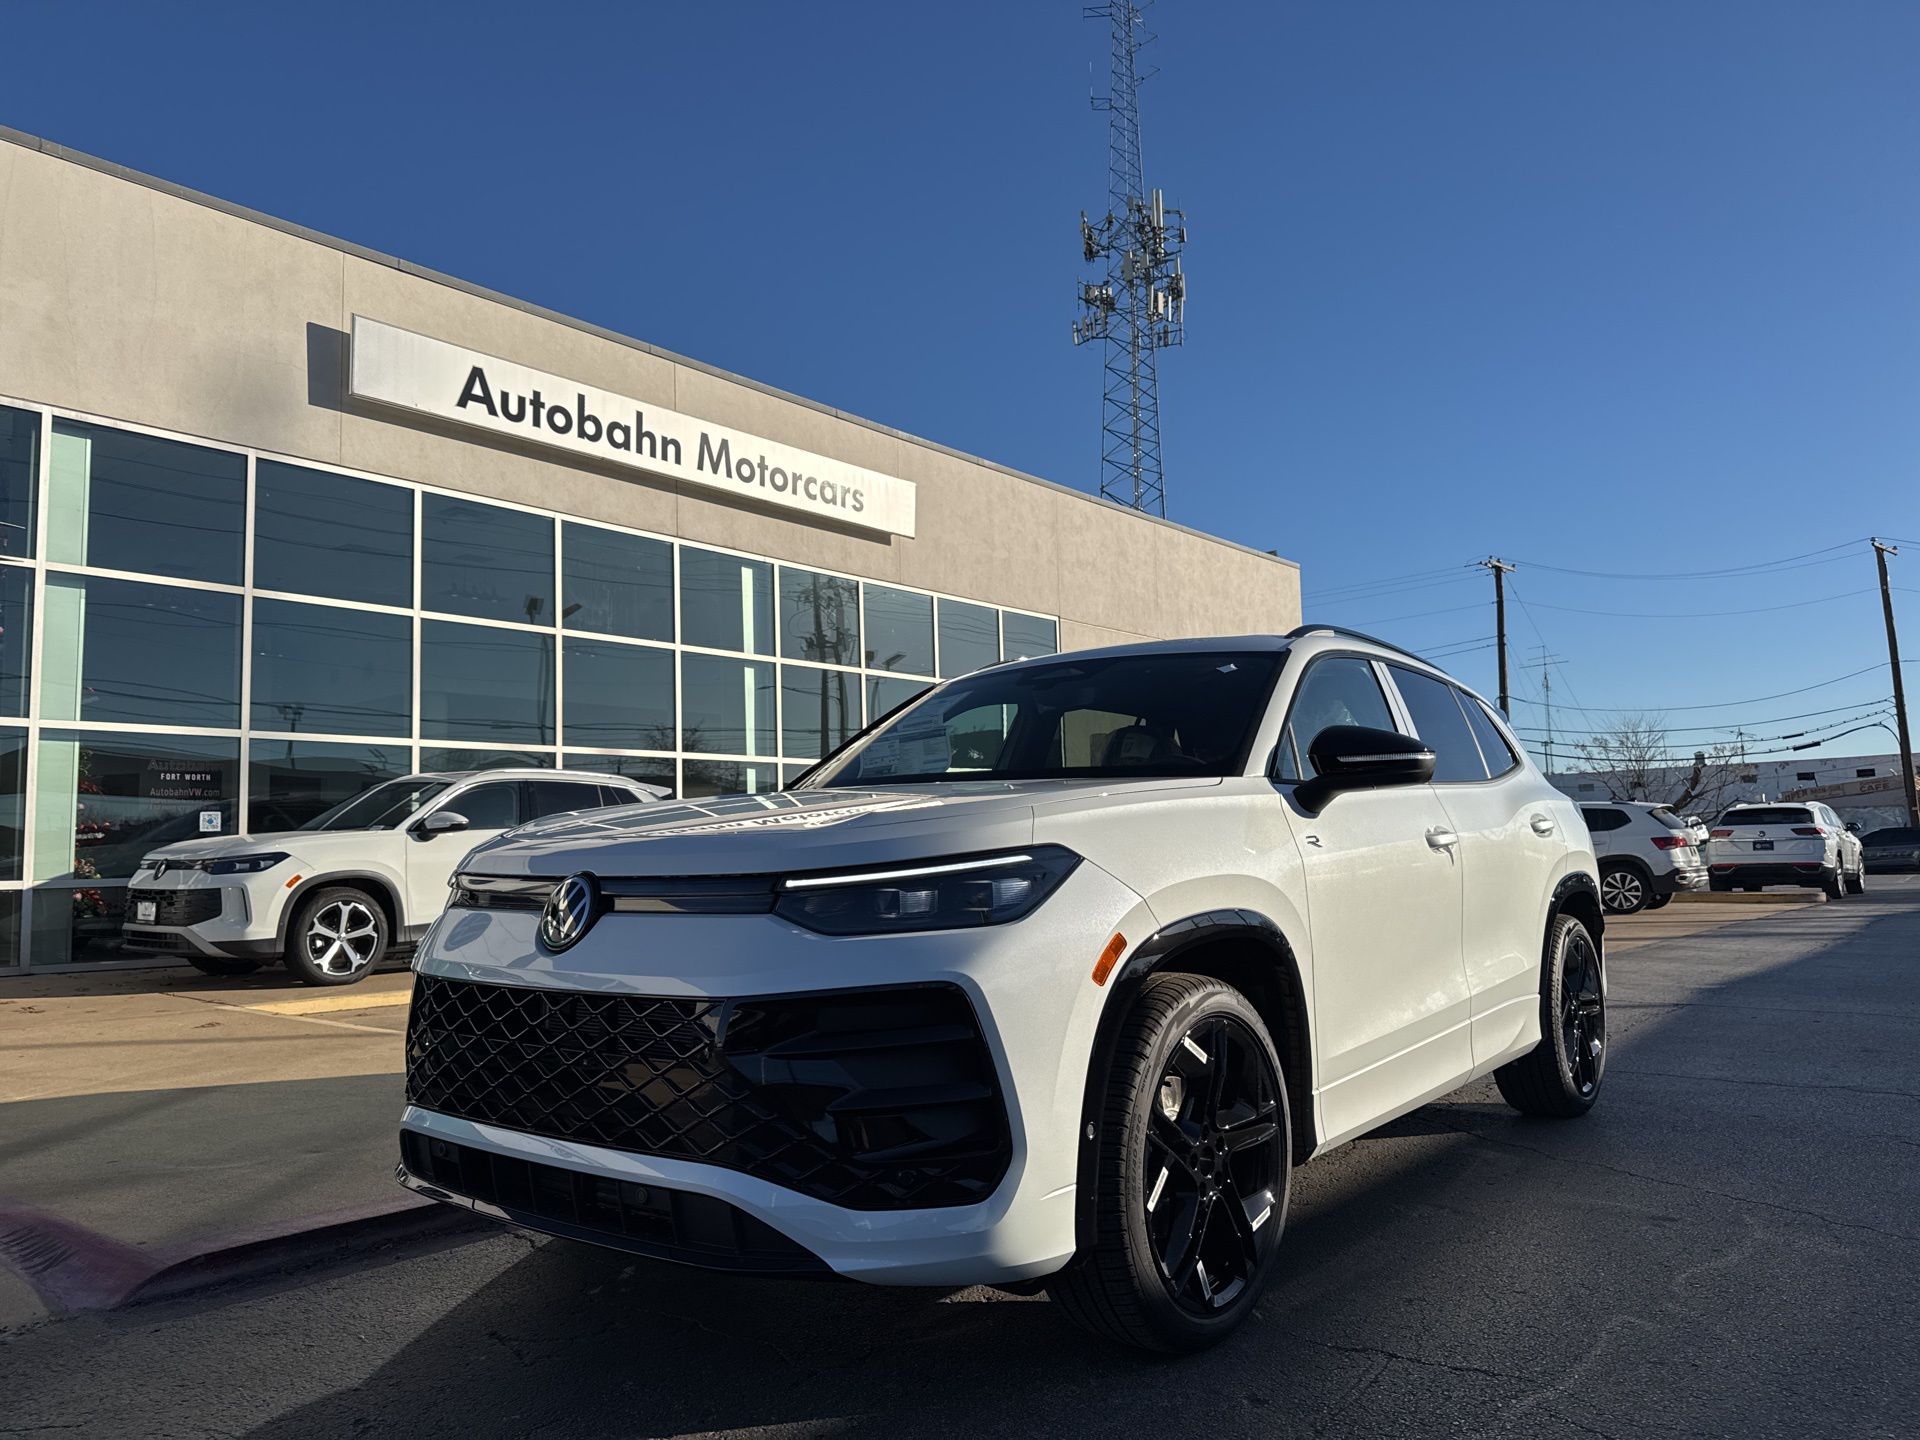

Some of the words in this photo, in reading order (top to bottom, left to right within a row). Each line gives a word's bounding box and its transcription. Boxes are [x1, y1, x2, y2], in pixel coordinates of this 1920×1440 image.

[455, 366, 681, 466] Autobahn
[697, 432, 865, 513] Motorcars
[147, 759, 222, 771] Autoba
[160, 773, 181, 781] FORT
[184, 773, 211, 781] WORTH
[150, 787, 220, 796] AutobahnVW.com
